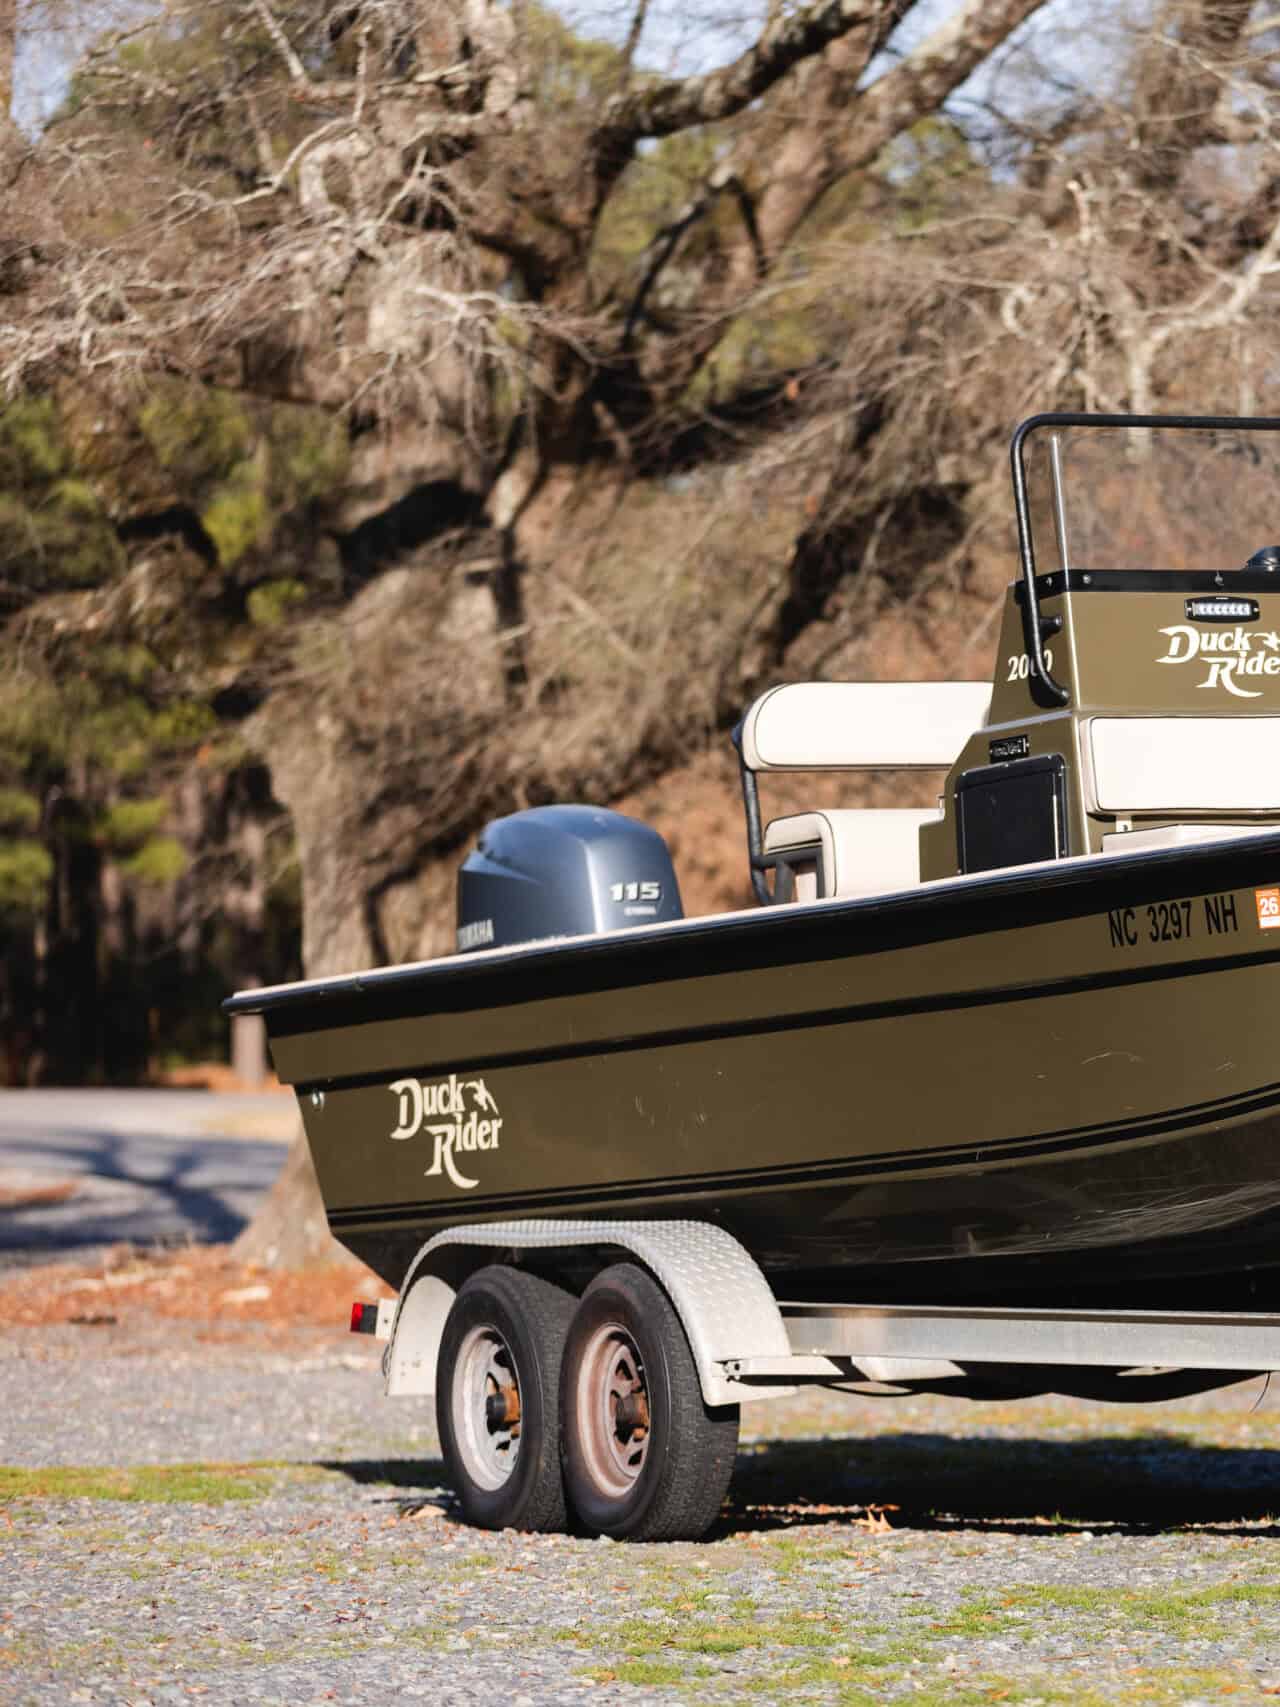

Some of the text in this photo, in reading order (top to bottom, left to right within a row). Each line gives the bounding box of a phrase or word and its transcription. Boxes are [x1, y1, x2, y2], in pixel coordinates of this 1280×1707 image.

[1155, 625, 1253, 664] Duck
[609, 882, 660, 900] 115
[1260, 896, 1279, 916] 26
[456, 918, 494, 951] MAHA
[1107, 895, 1238, 948] NC 3297 NH
[388, 1074, 465, 1140] Duck
[424, 1111, 503, 1189] Rider
